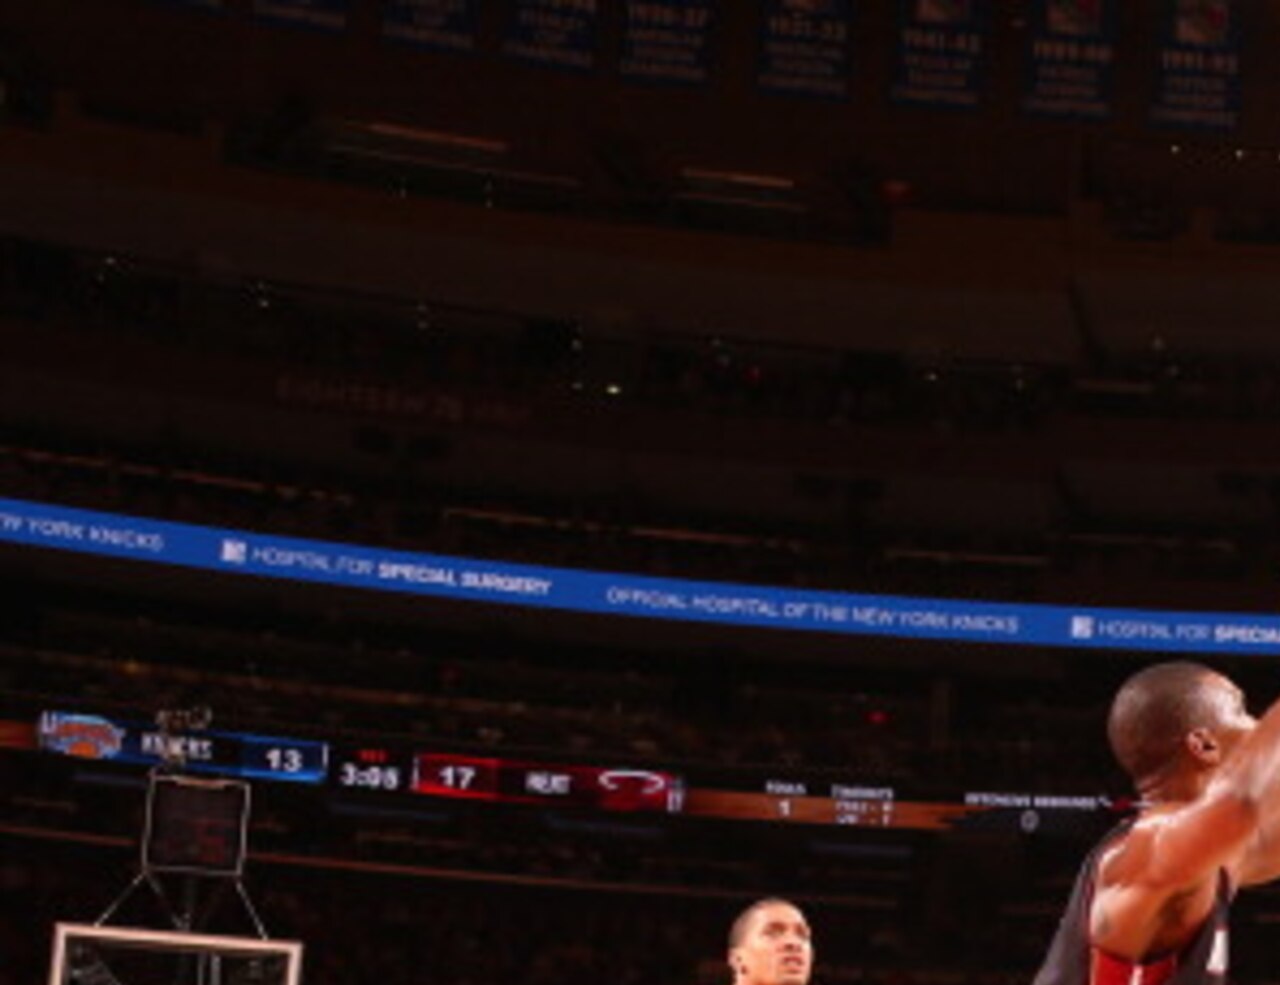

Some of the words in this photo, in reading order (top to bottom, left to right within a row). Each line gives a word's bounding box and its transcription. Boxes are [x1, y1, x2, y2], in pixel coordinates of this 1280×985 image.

[28, 518, 83, 540] YORK
[89, 526, 164, 552] KNICKS
[253, 547, 329, 570] HOSPITAL
[337, 556, 373, 575] FOR
[378, 562, 457, 586] SPECIAL
[460, 571, 552, 595] SURGERY
[606, 587, 688, 609] OFFICIAL
[692, 595, 781, 617] HOSPITAL
[784, 602, 808, 618] OF
[813, 603, 848, 623] THE
[852, 606, 894, 626] NEW
[899, 610, 948, 630] YORK
[952, 615, 1019, 635] KNICKS
[1098, 619, 1171, 640] HOSPITAL
[1175, 624, 1210, 642] FOR
[266, 748, 303, 773] 13
[440, 765, 475, 790] 17
